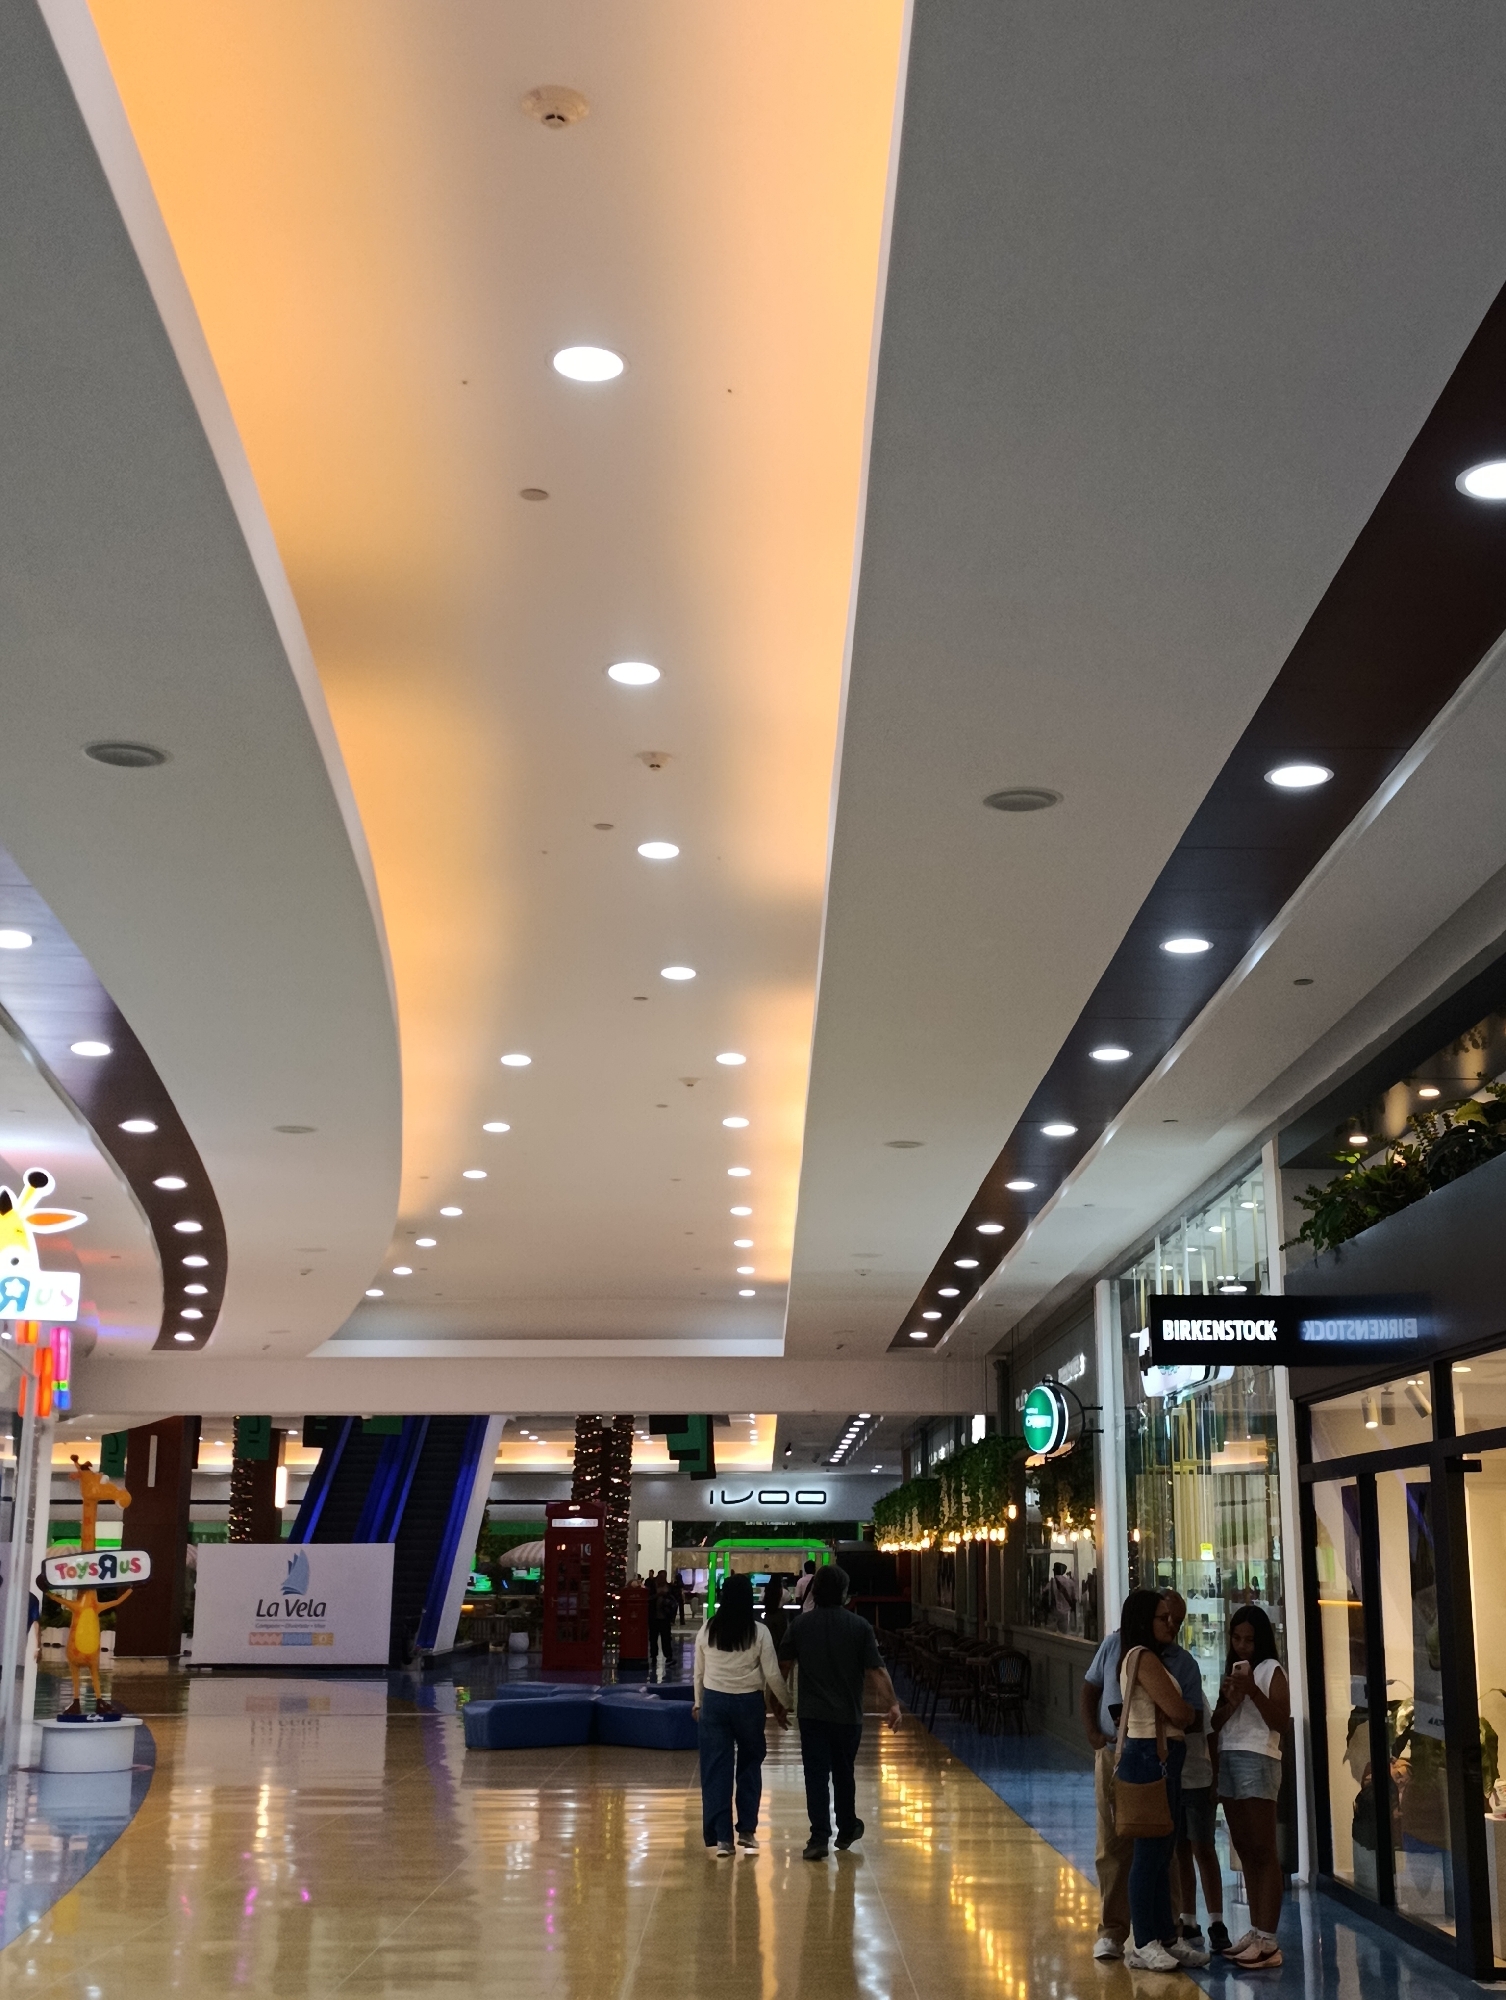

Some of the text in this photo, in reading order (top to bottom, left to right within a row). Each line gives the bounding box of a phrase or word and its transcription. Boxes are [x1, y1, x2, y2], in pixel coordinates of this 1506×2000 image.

[1163, 1319, 1276, 1341] BIRKENSTOCK
[256, 1599, 327, 1617] La Vela
